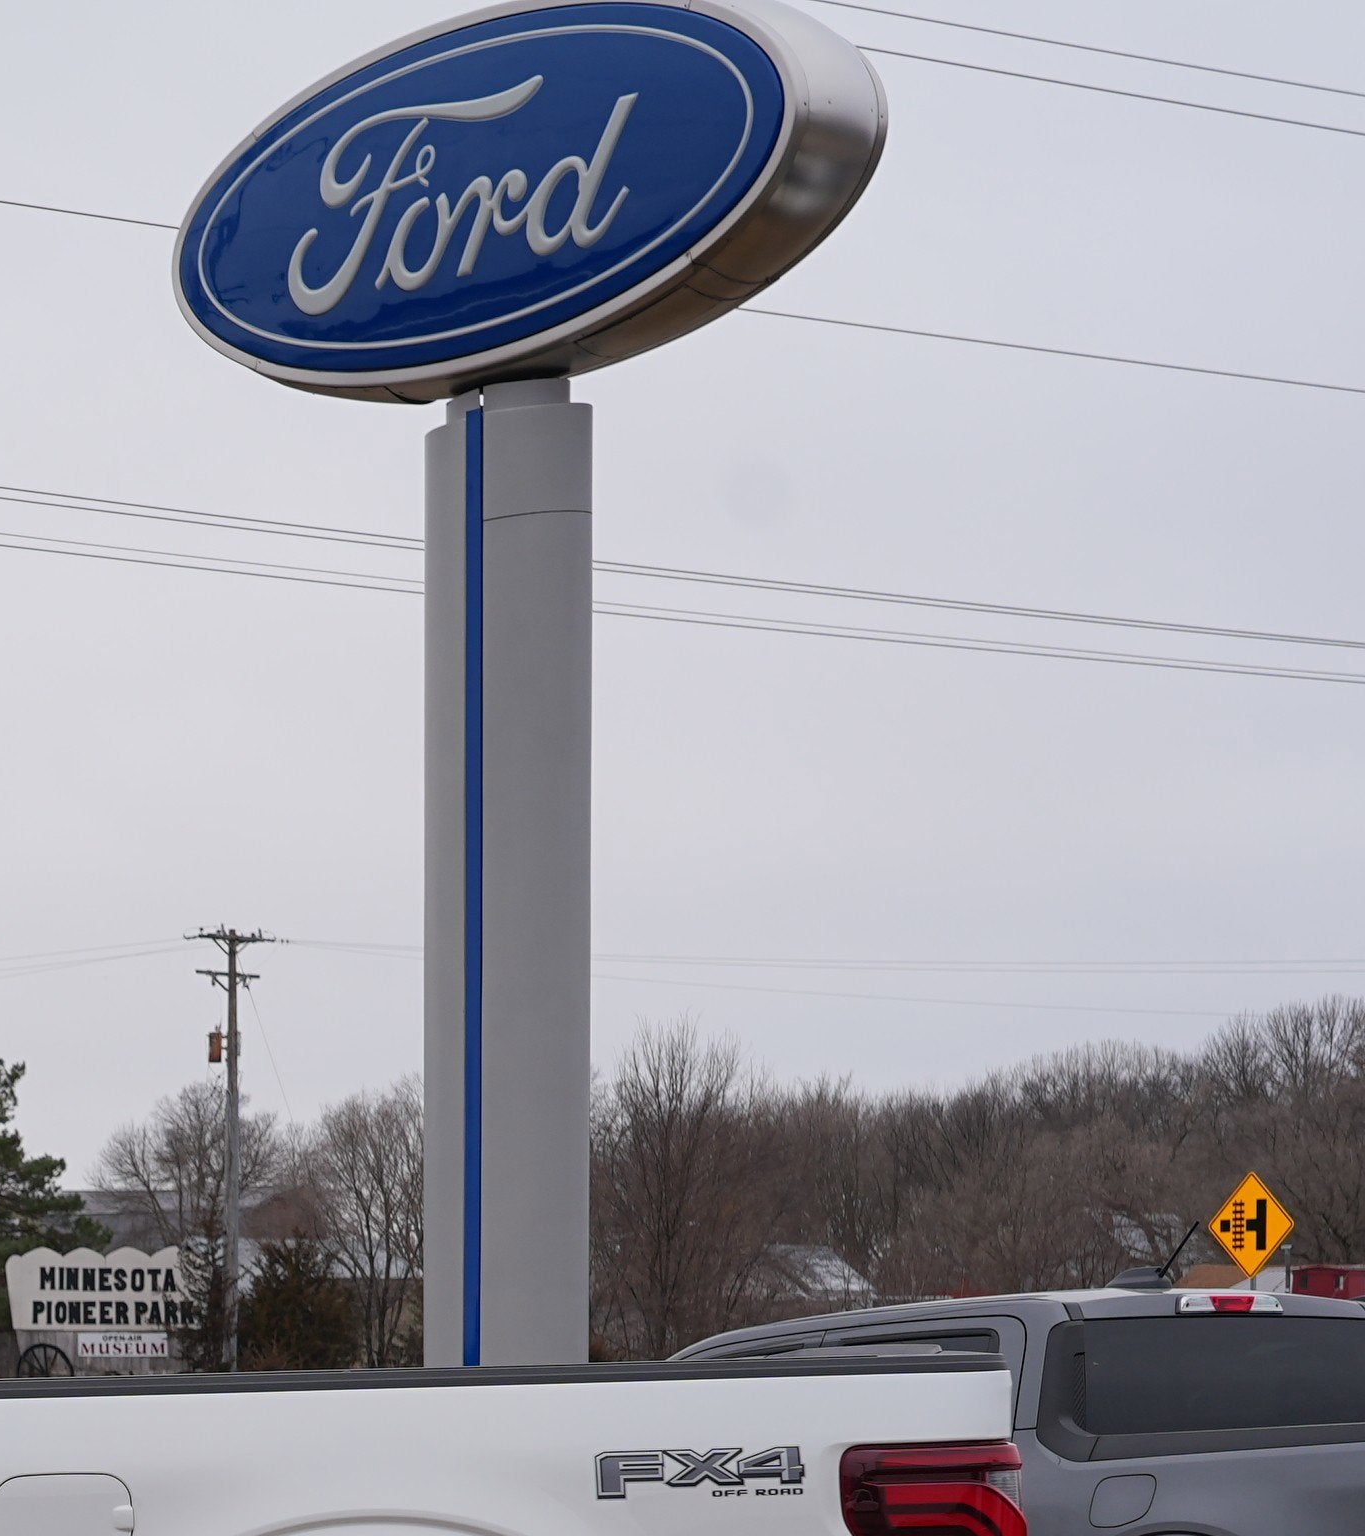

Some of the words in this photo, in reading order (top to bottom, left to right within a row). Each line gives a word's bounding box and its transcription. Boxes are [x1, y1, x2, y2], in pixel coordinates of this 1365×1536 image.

[287, 74, 639, 316] Ford
[39, 1266, 177, 1292] MINNESOTA
[32, 1301, 129, 1325] PIONEER
[134, 1301, 196, 1325] PARK
[81, 1342, 166, 1355] MUSEUM
[101, 1334, 143, 1342] OPEN-AIR
[594, 1445, 805, 1500] FX4
[711, 1488, 748, 1498] OFF
[755, 1487, 804, 1497] ROAD
